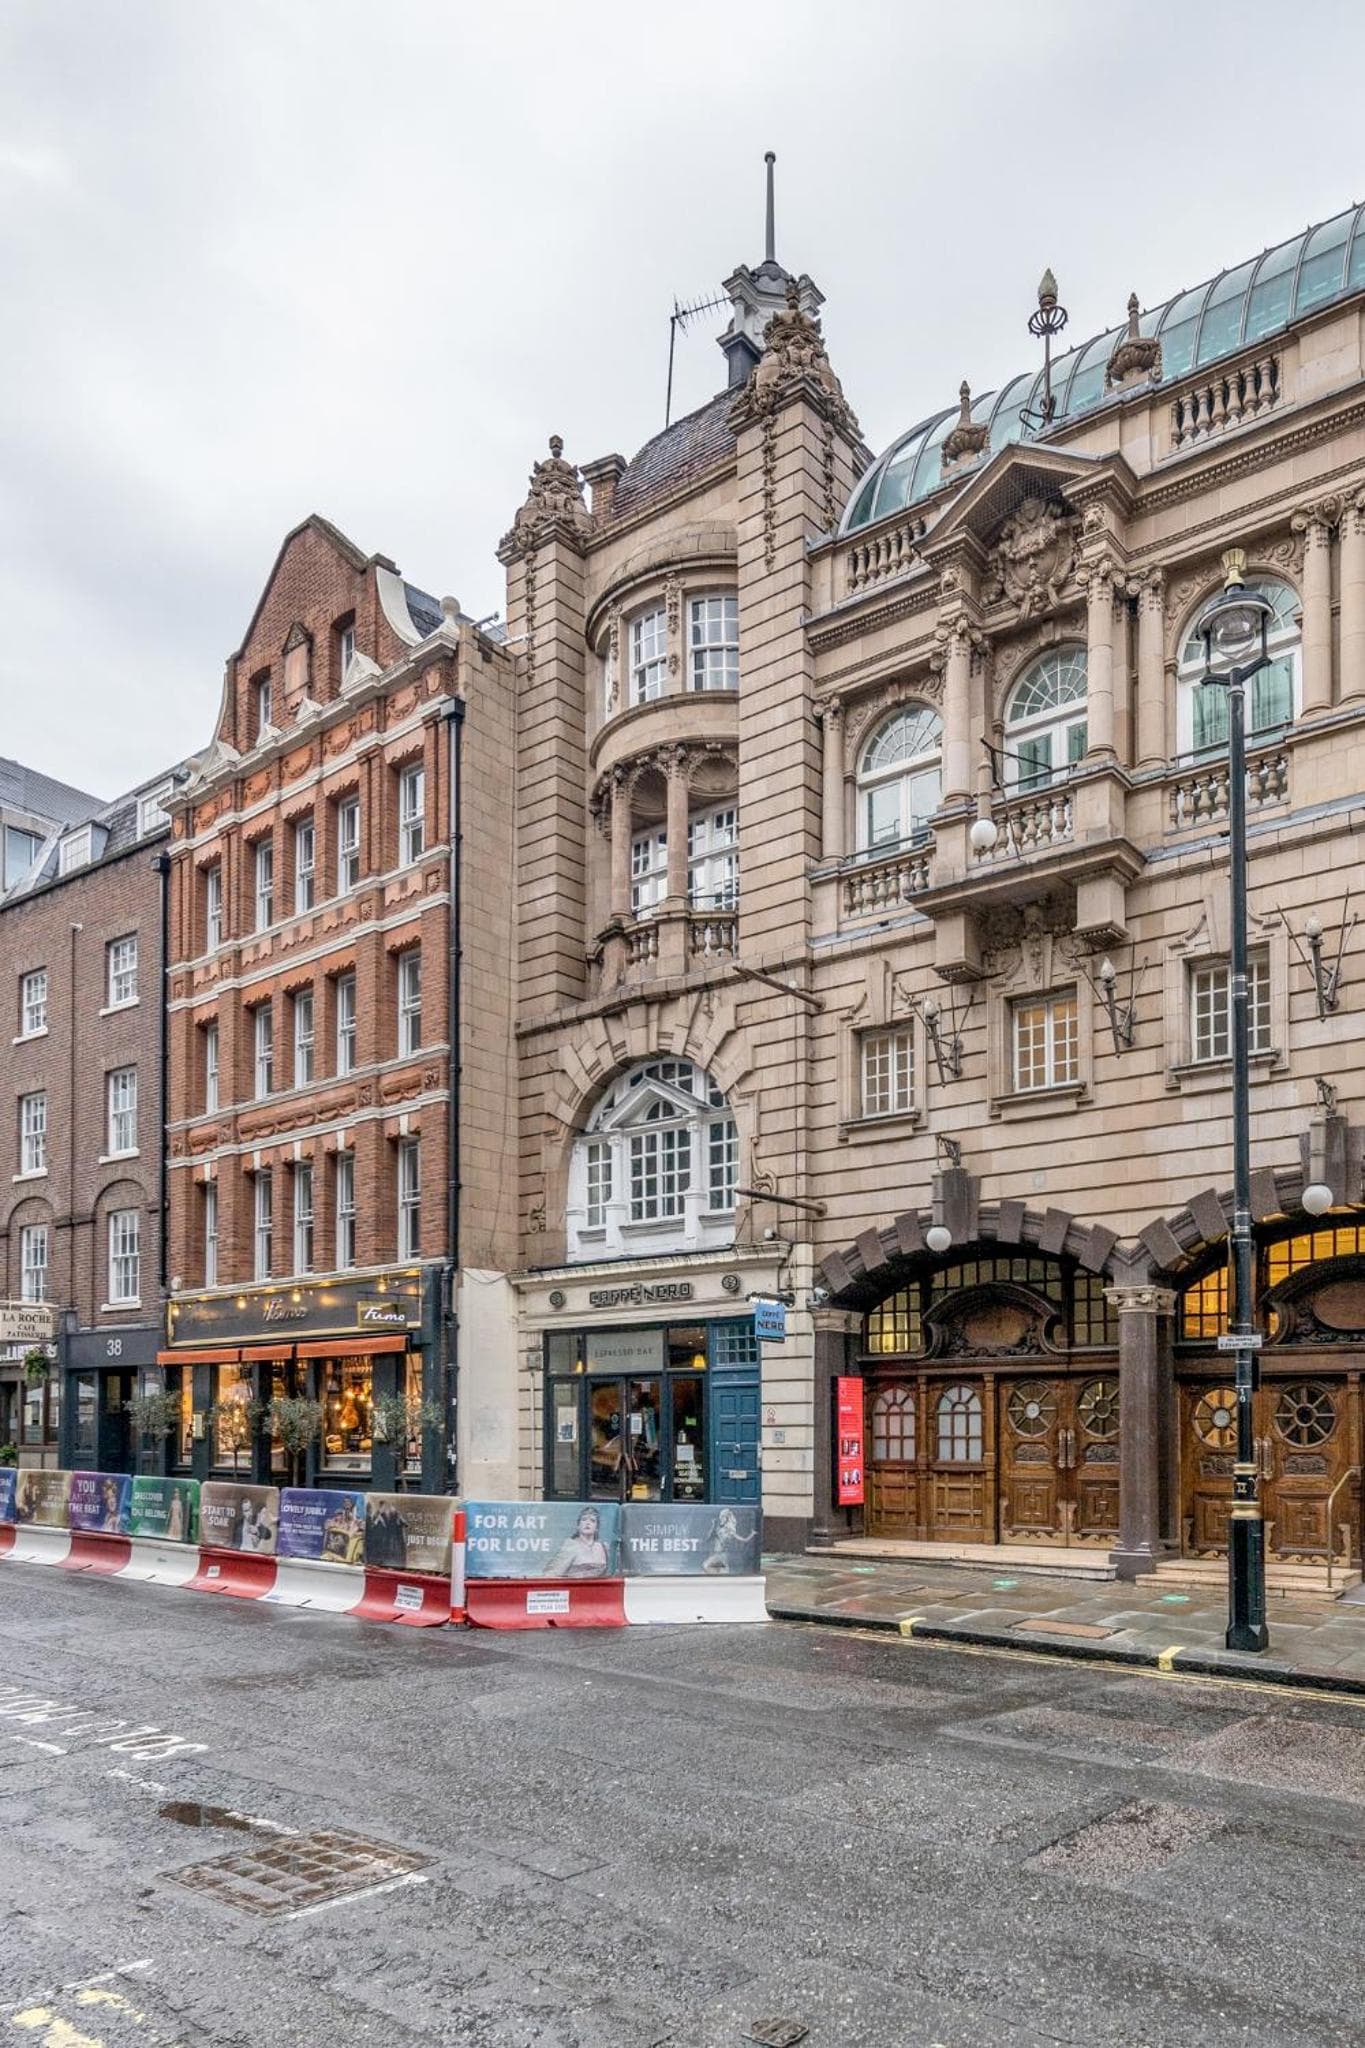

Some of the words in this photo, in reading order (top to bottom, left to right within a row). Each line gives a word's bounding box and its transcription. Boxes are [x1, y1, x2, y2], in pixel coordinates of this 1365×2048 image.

[643, 1282, 692, 1301] NERO
[3, 1313, 15, 1322] LA
[19, 1313, 51, 1323] ROCHE
[363, 1307, 405, 1321] Fumo
[757, 1321, 785, 1331] NERO
[107, 1340, 122, 1356] 38
[77, 1480, 95, 1493] YOU
[69, 1502, 84, 1514] THE
[84, 1504, 100, 1515] BEAT
[201, 1505, 225, 1517] START
[226, 1507, 236, 1518] TO
[281, 1504, 304, 1514] LOVELY
[475, 1514, 508, 1529] FOR
[512, 1515, 548, 1530] ART
[644, 1523, 689, 1536] SIMPLY
[406, 1535, 425, 1546] JUST
[468, 1537, 501, 1552] FOR
[506, 1537, 552, 1552] LOVE
[629, 1537, 659, 1552] THE
[663, 1537, 700, 1552] BEST
